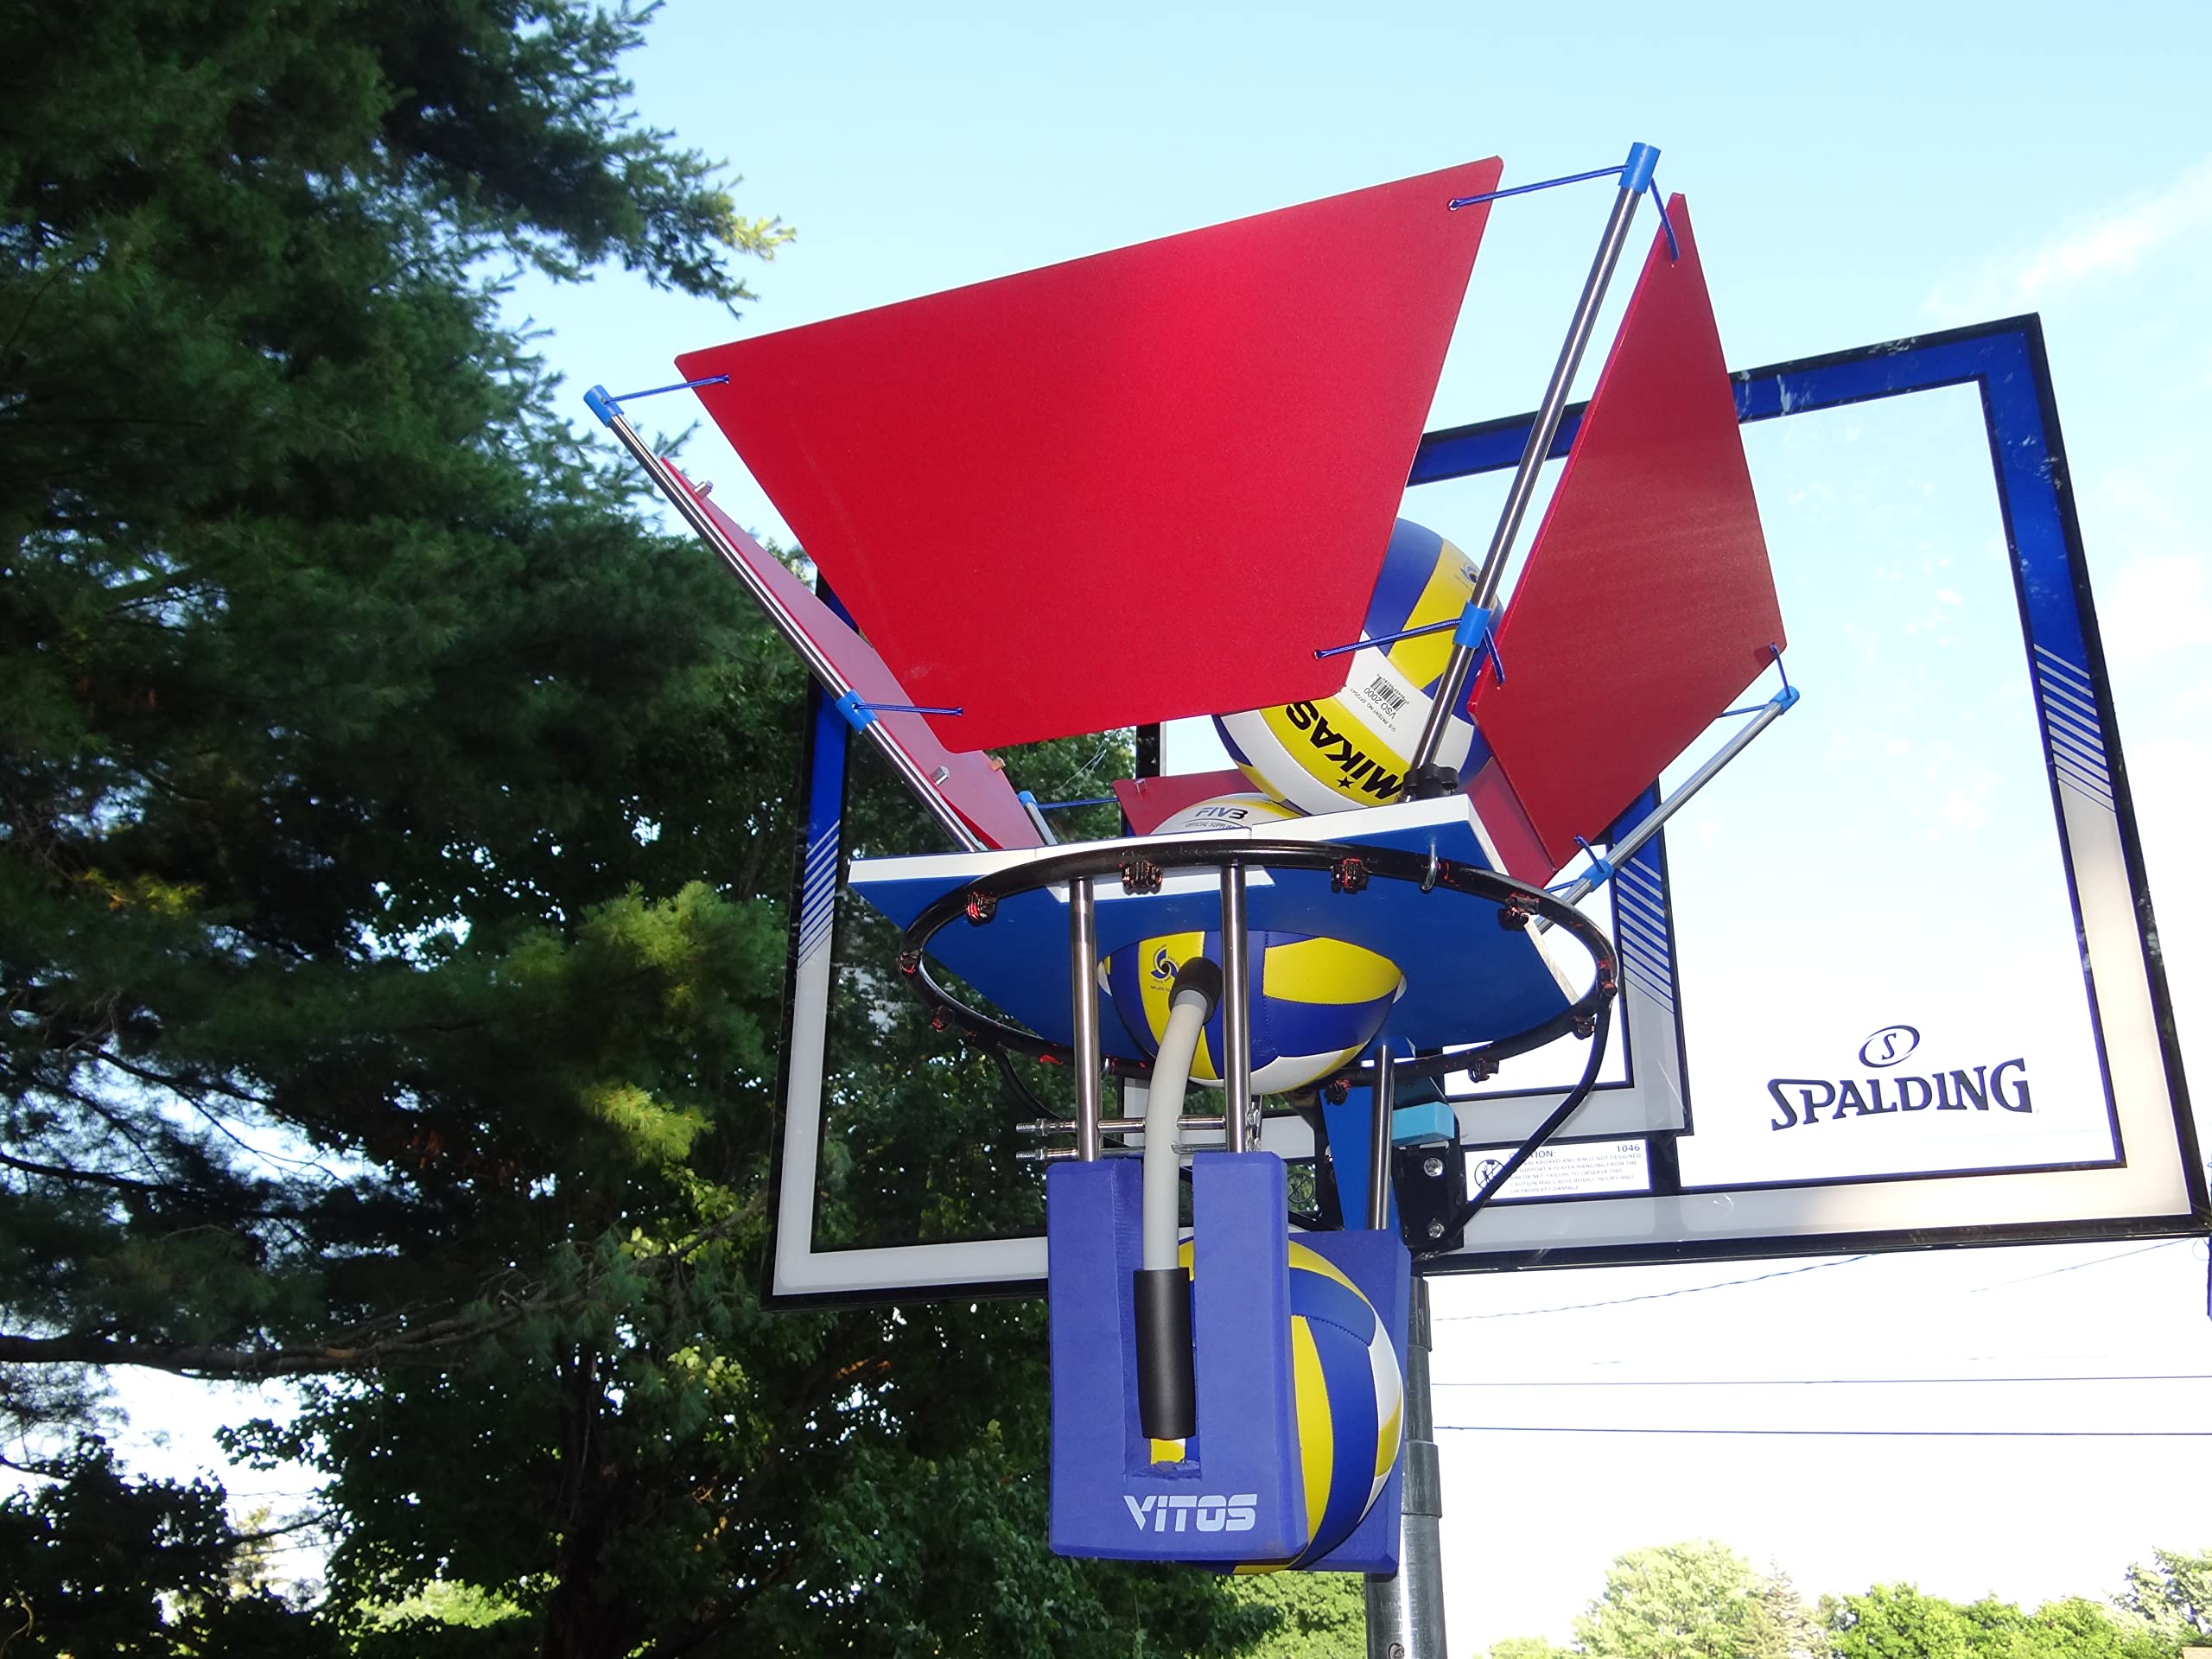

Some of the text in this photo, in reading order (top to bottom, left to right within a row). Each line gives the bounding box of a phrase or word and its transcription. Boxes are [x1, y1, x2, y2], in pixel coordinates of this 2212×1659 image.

[1363, 687, 1382, 704] 2000
[1372, 709, 1389, 725] PATENT
[1380, 702, 1396, 720] VSO
[1767, 1058, 2033, 1131] SPALDING
[1617, 1144, 1641, 1153] 1046
[1123, 1494, 1258, 1532] VITOS
